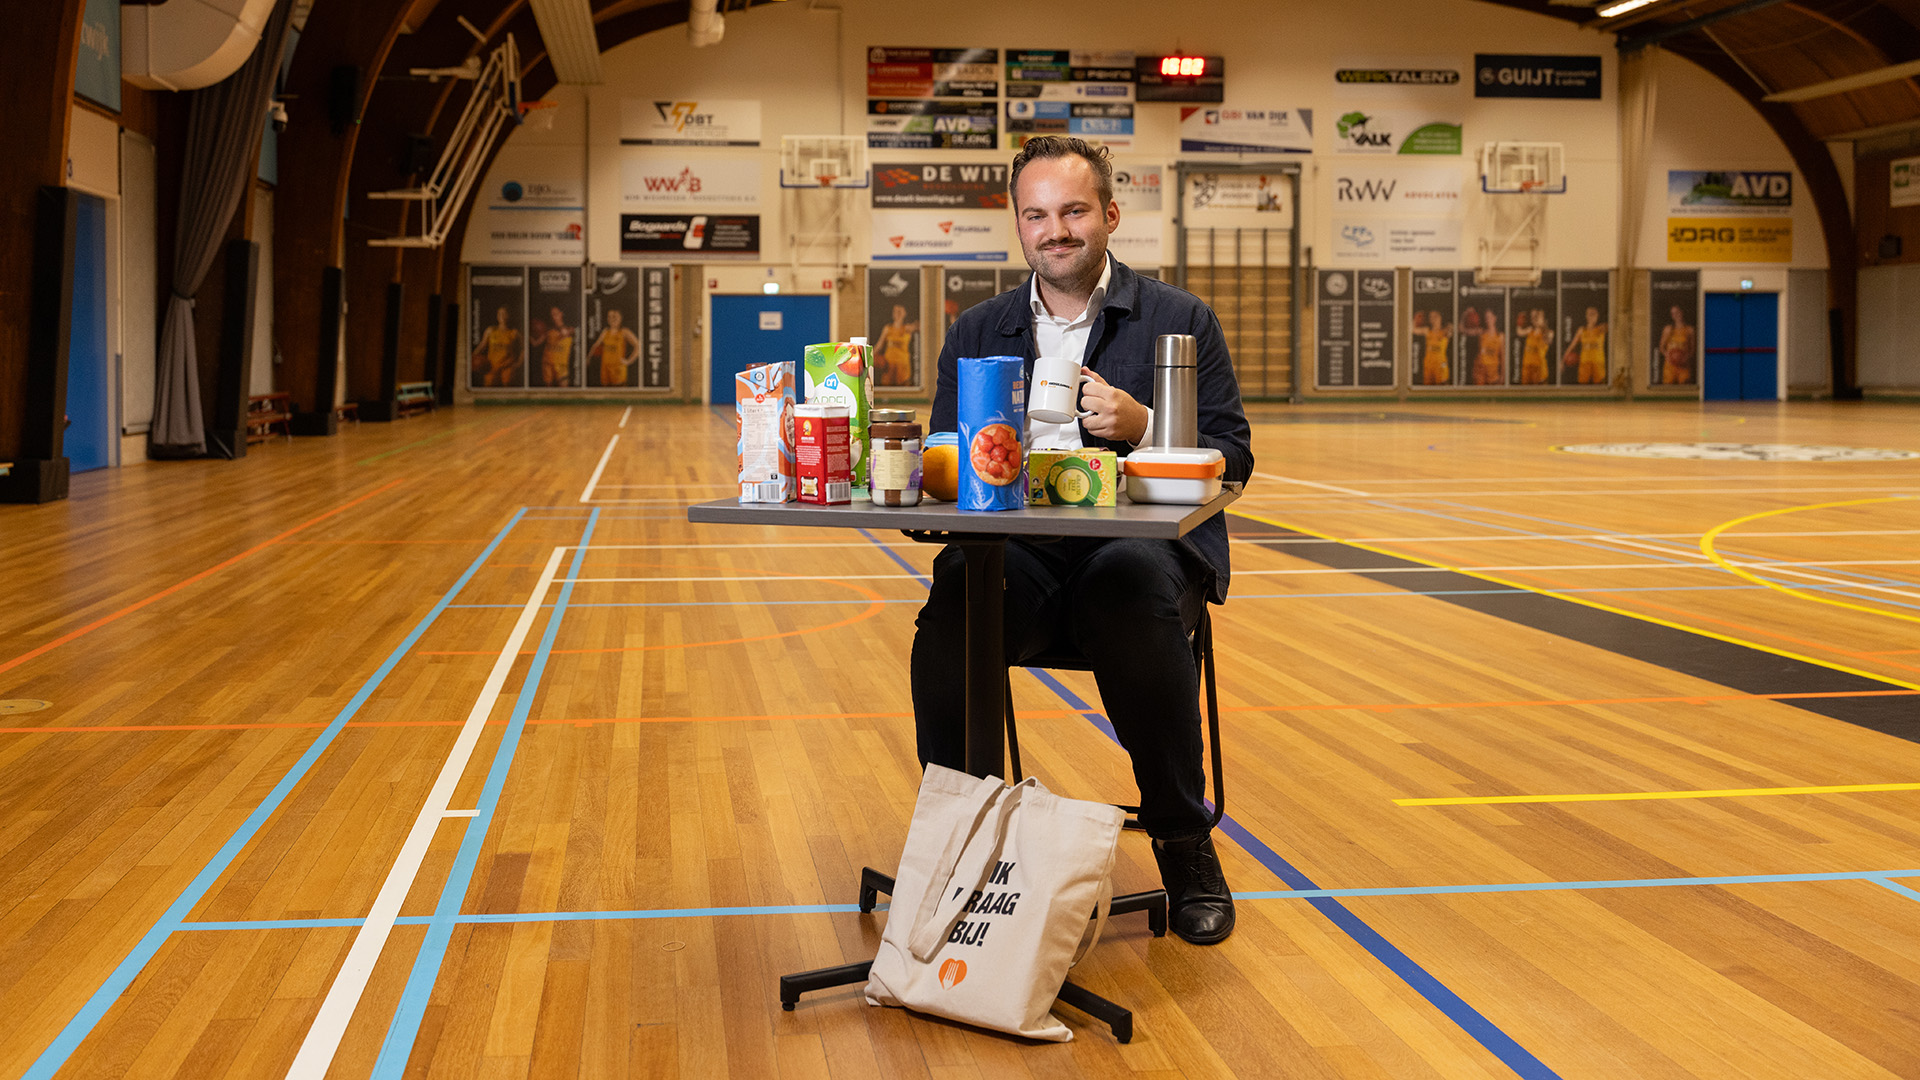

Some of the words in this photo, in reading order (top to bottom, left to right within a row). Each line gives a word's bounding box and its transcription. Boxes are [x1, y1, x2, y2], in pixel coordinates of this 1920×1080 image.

[1498, 67, 1554, 86] GUIJT
[684, 114, 713, 125] DBT
[934, 116, 971, 132] AVD
[1351, 133, 1392, 147] VALK
[922, 165, 953, 182] DE
[959, 166, 1006, 183] WIT
[1730, 174, 1790, 198] AVD
[988, 861, 1016, 885] IK
[947, 920, 991, 947] BIJ!
